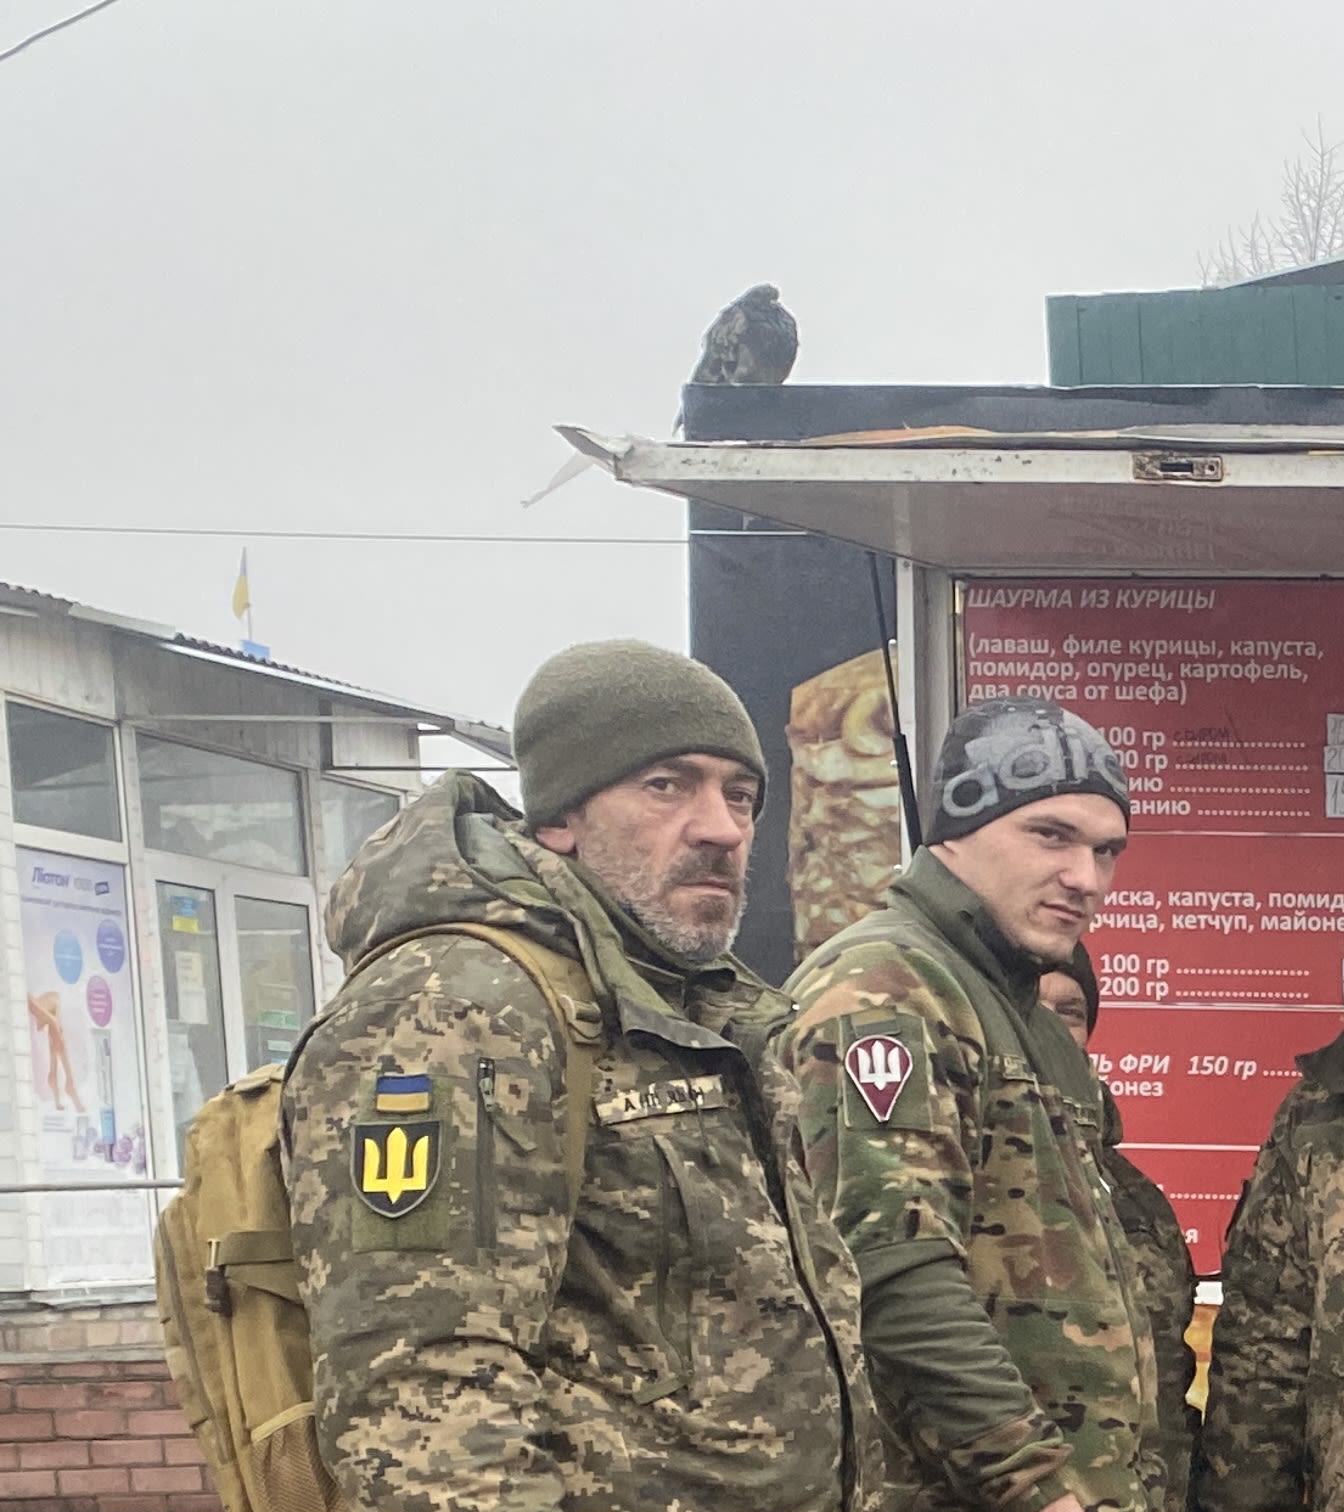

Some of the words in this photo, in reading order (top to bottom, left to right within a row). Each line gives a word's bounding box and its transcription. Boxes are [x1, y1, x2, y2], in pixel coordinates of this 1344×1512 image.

[968, 588, 1073, 609] ШАУРМА
[1080, 588, 1109, 608] ИЗ
[1115, 588, 1216, 613] КУРИЦЫ
[968, 633, 1055, 656] (лаваш,
[1063, 635, 1121, 659] филе
[1129, 637, 1224, 660] курицы,
[1231, 639, 1324, 660] капуста,
[968, 660, 1081, 681] помидор,
[1087, 660, 1174, 681] огурец,
[1180, 660, 1309, 684] картофель,
[968, 684, 1009, 702] два
[1016, 682, 1078, 701] соуса
[1084, 683, 1109, 701] от
[1115, 681, 1187, 704] шефа)
[1142, 730, 1166, 750] гр
[1115, 750, 1139, 769] 00
[1145, 751, 1168, 771] гр
[1129, 799, 1191, 816] анию
[1104, 890, 1161, 909] иска,
[1167, 890, 1261, 912] капуста,
[1088, 911, 1165, 933] рчица,
[1172, 912, 1254, 934] кетчуп,
[1100, 954, 1140, 974] 100
[1146, 957, 1169, 978] гр
[1100, 977, 1140, 996] 200
[1146, 980, 1169, 1001] гр
[1119, 1055, 1171, 1075] ФРИ
[1187, 1055, 1229, 1076] 150
[1233, 1059, 1257, 1080] гр
[1099, 1076, 1164, 1097] онез
